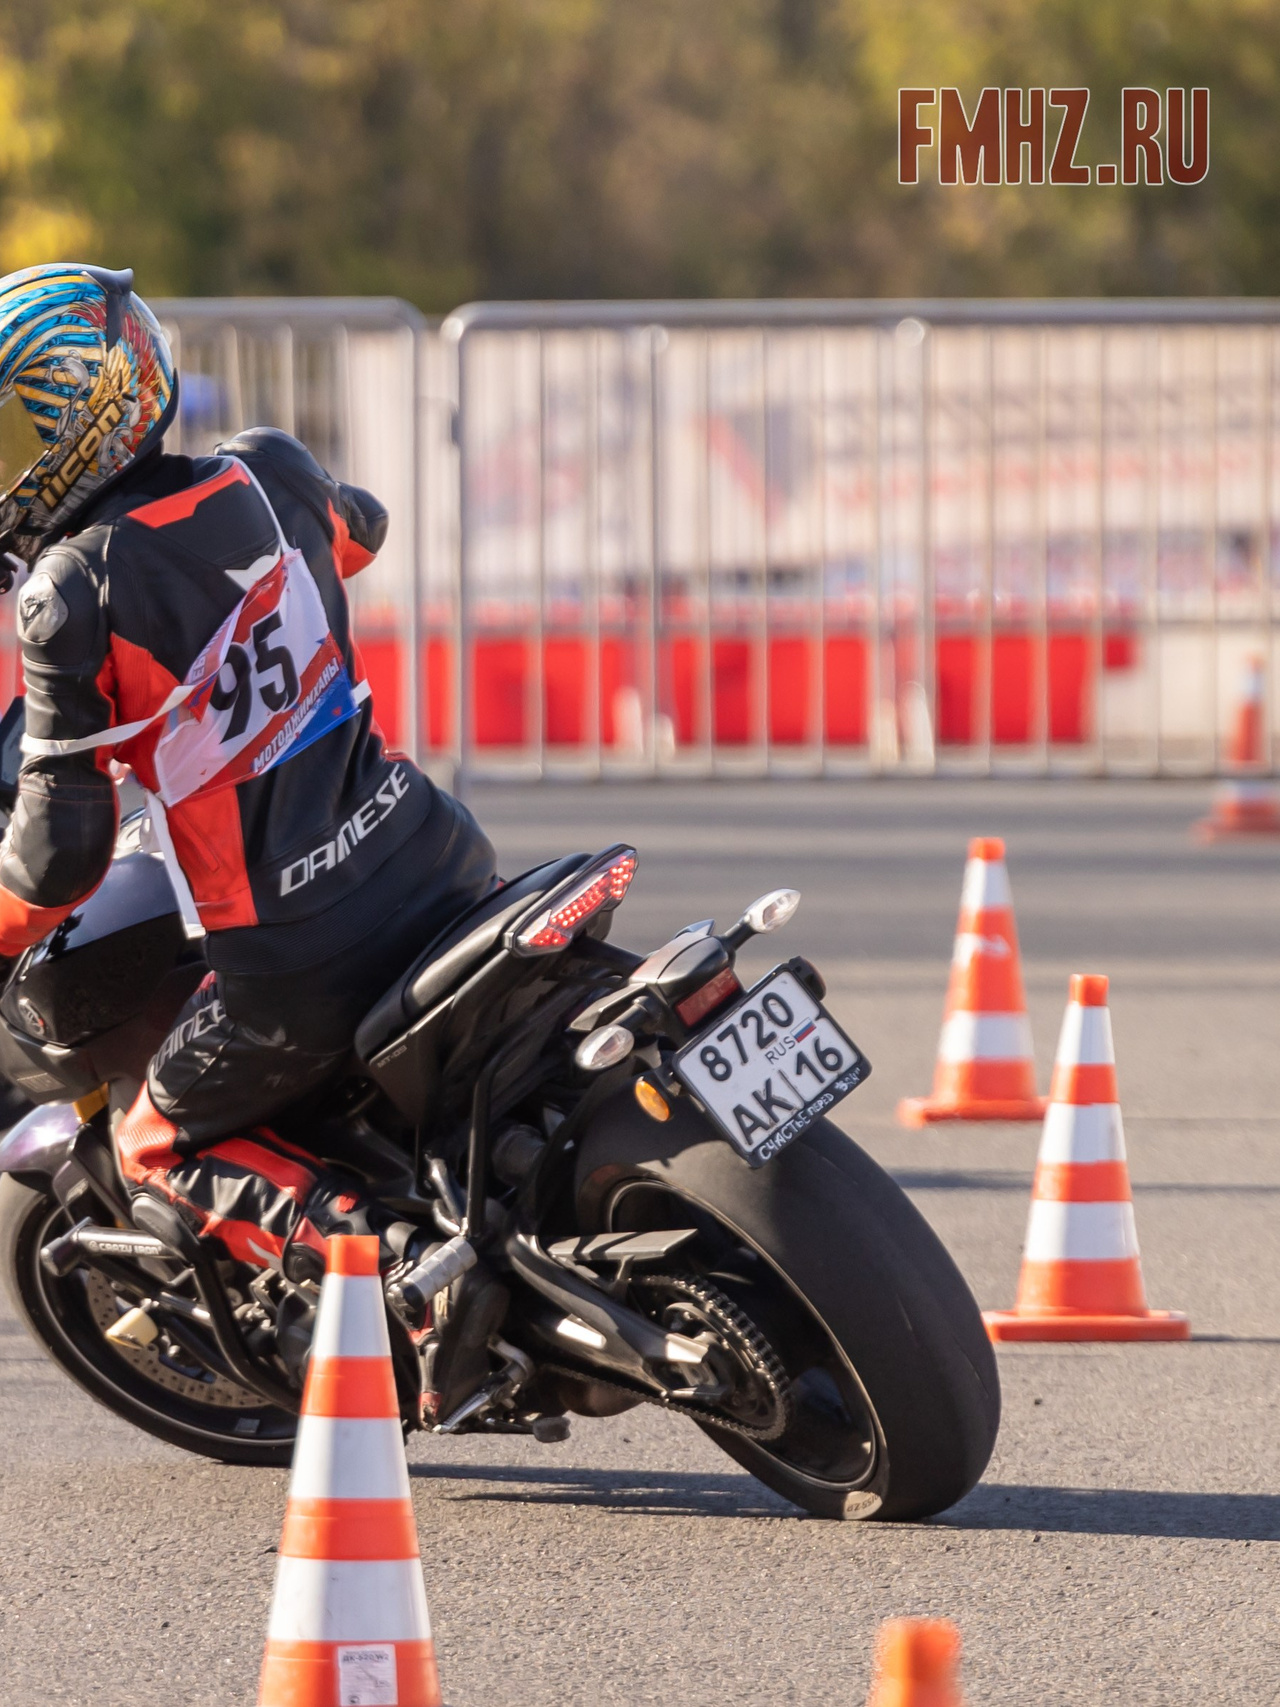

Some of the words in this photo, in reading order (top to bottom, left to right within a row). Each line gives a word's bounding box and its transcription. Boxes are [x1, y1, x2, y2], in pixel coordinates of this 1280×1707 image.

[209, 609, 300, 745] 95
[251, 656, 340, 774] МОТОДЖИМХАНЫ
[280, 763, 410, 897] DAINESE
[700, 992, 794, 1082] 8720
[765, 1036, 796, 1065] RUS
[732, 1077, 796, 1146] AK
[796, 1036, 843, 1084] 16
[758, 1111, 811, 1160] СЧАСТЬЕ
[99, 1242, 133, 1254] CRAZY
